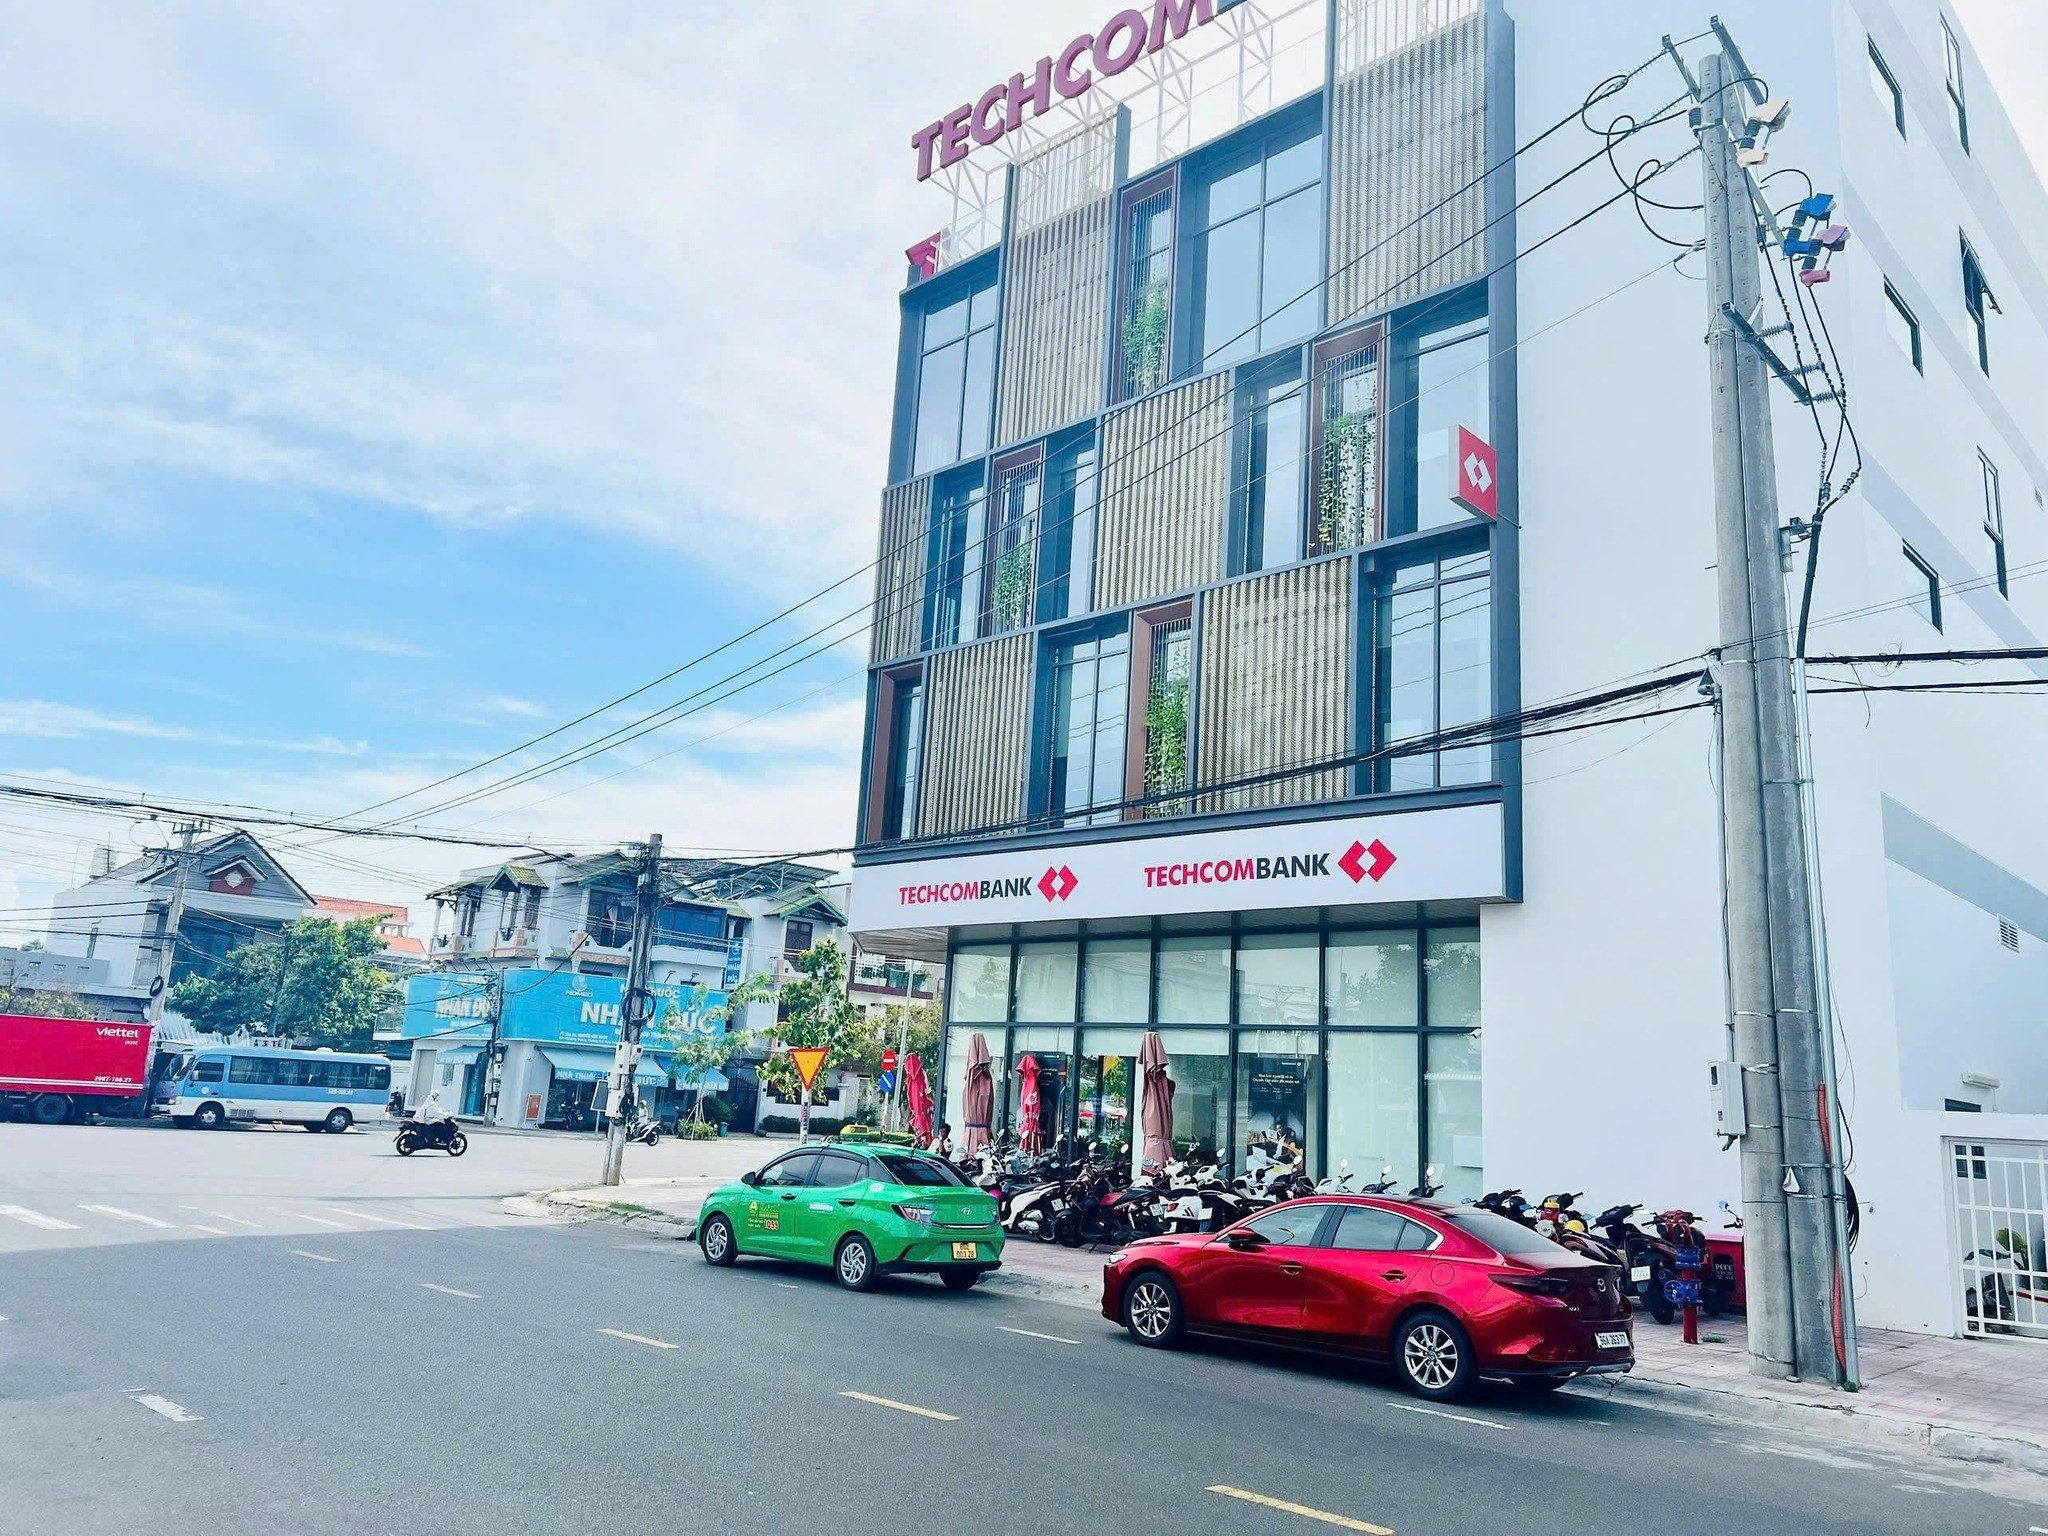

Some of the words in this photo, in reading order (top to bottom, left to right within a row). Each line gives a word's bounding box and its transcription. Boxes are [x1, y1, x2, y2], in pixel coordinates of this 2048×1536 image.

[911, 0, 1247, 182] TECHCOM
[1144, 852, 1330, 888] TECHCOMBANK
[899, 876, 1033, 905] TECHCOMBANK
[645, 983, 680, 999] HUỐC
[580, 999, 656, 1029] NHN
[96, 1026, 139, 1038] viettel
